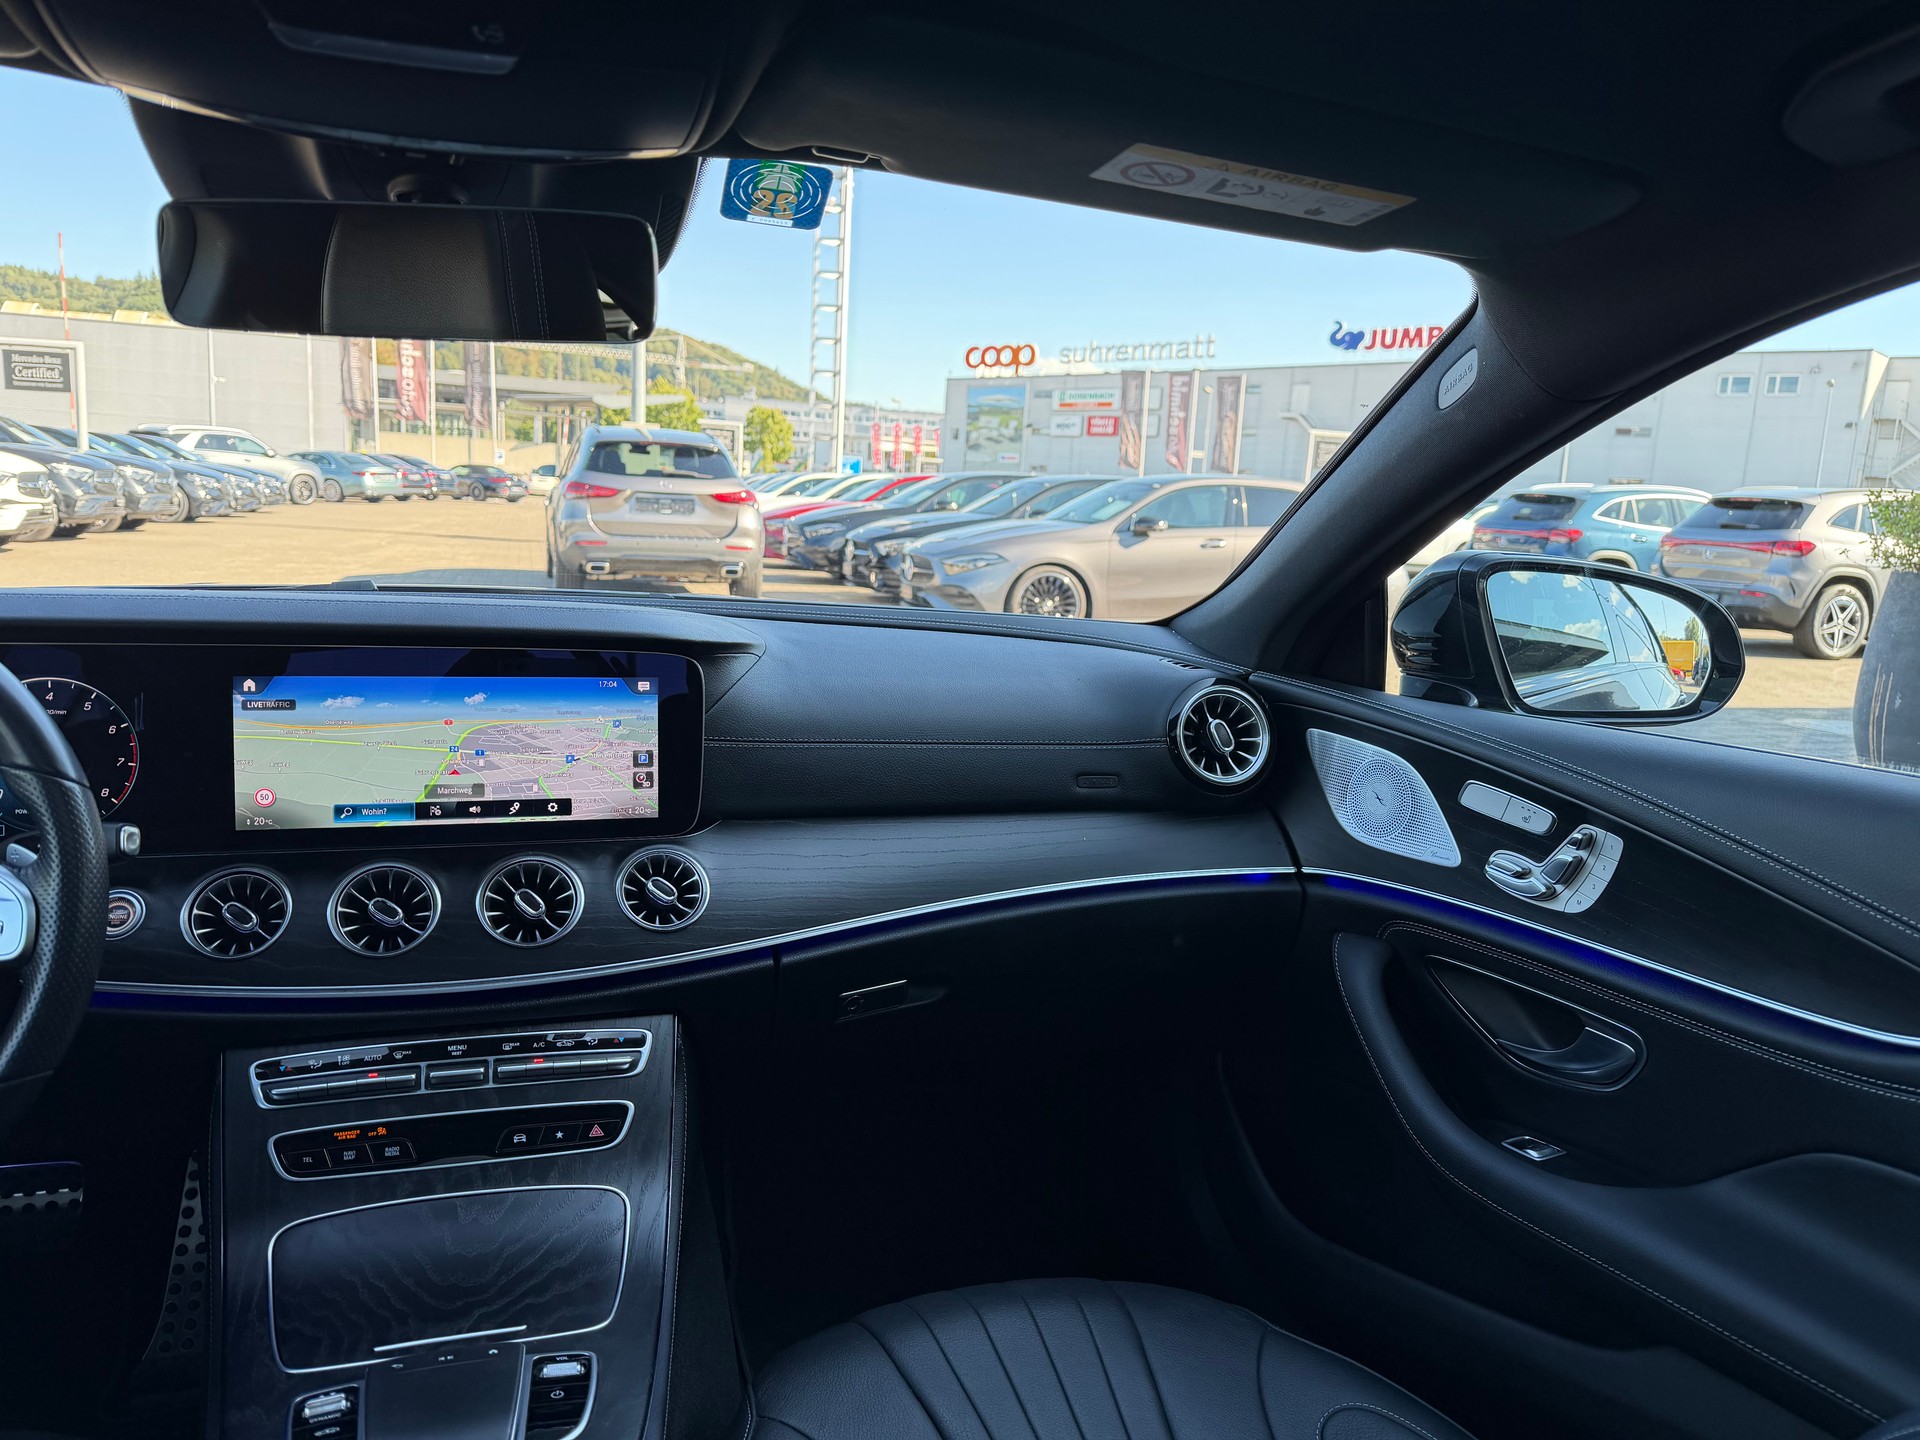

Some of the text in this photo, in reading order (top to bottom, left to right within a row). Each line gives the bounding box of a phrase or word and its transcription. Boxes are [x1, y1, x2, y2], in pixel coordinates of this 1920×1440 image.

[1242, 168, 1340, 190] AIRBAG
[1059, 334, 1216, 364] suhrenmatt
[965, 343, 1036, 376] coop
[14, 366, 60, 379] Certified
[1443, 363, 1474, 395] AIRBAG
[45, 692, 54, 701] 4
[83, 702, 92, 711] 5
[108, 725, 117, 734] 6
[116, 758, 125, 767] 7
[100, 788, 109, 797] 8
[437, 787, 473, 795] Marchweg
[361, 808, 387, 816] Wohin?
[447, 1044, 467, 1052] MENU
[333, 1129, 361, 1137] PASSENGER
[309, 1412, 341, 1424] DYNAMIC
